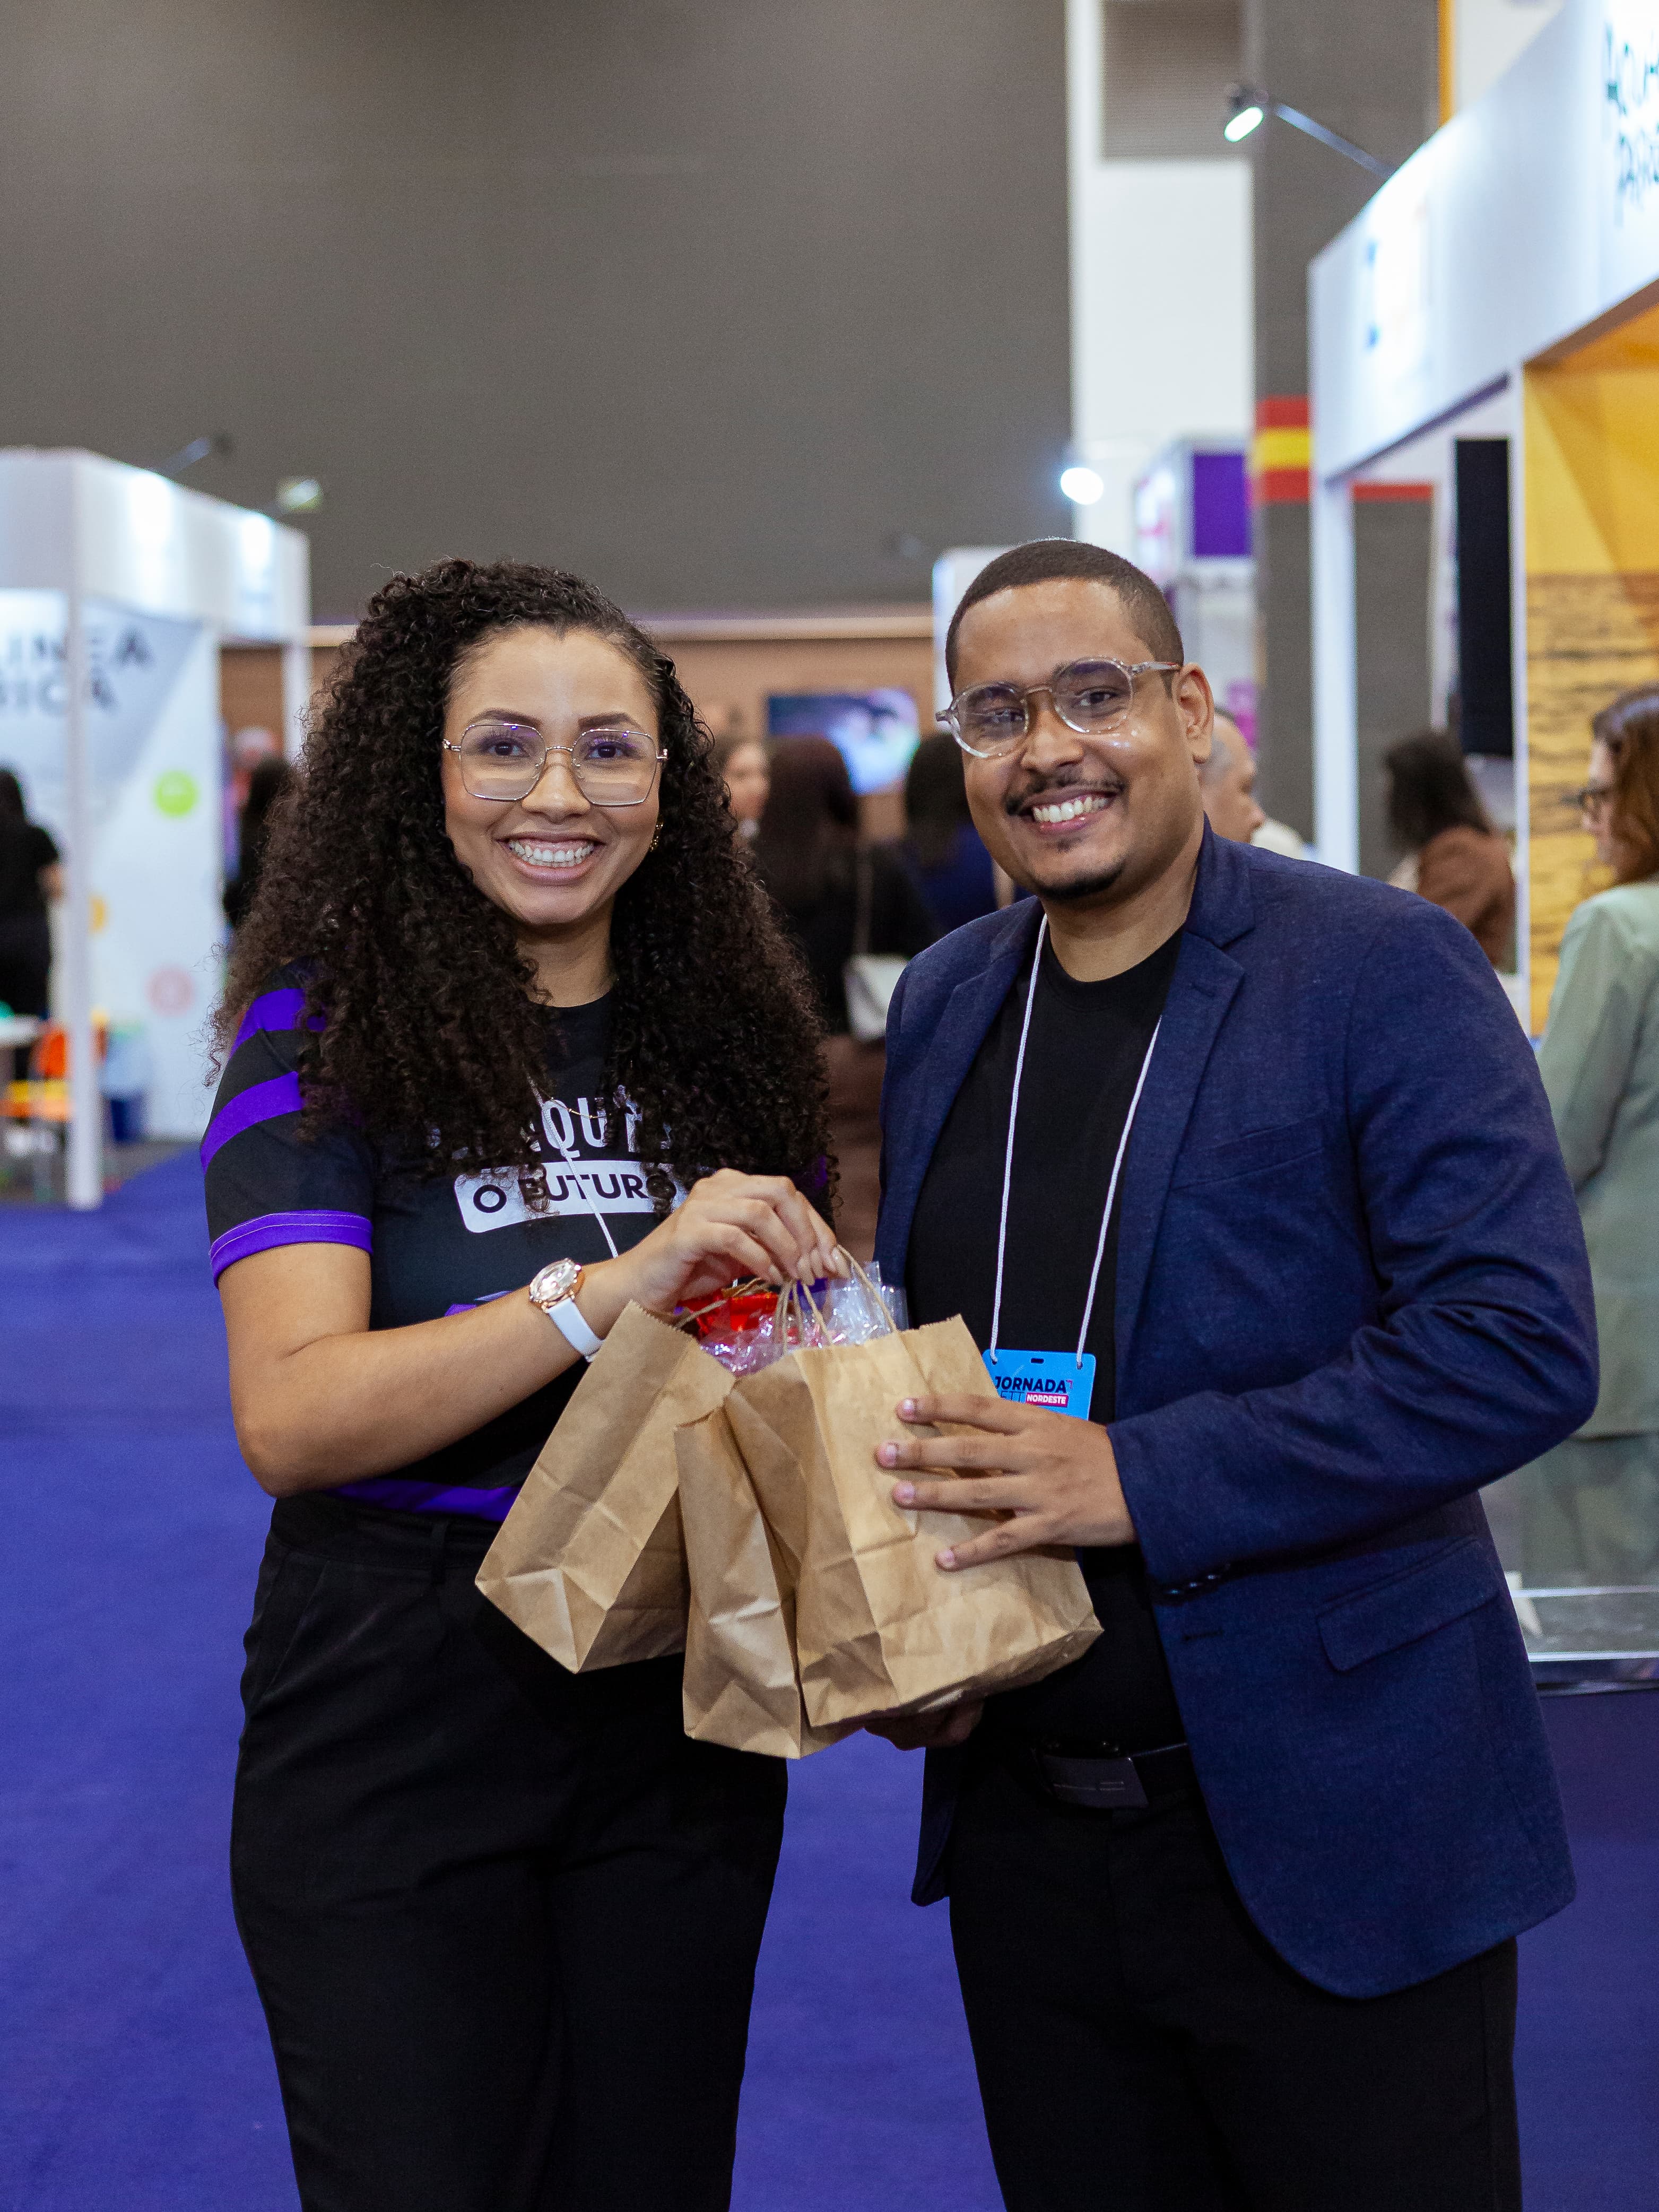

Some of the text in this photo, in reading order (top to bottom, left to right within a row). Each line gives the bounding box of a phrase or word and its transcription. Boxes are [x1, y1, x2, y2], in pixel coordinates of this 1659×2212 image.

[473, 1184, 507, 1213] O
[994, 1376, 1067, 1393] JORNADA
[1027, 1394, 1066, 1404] NORDESTE
